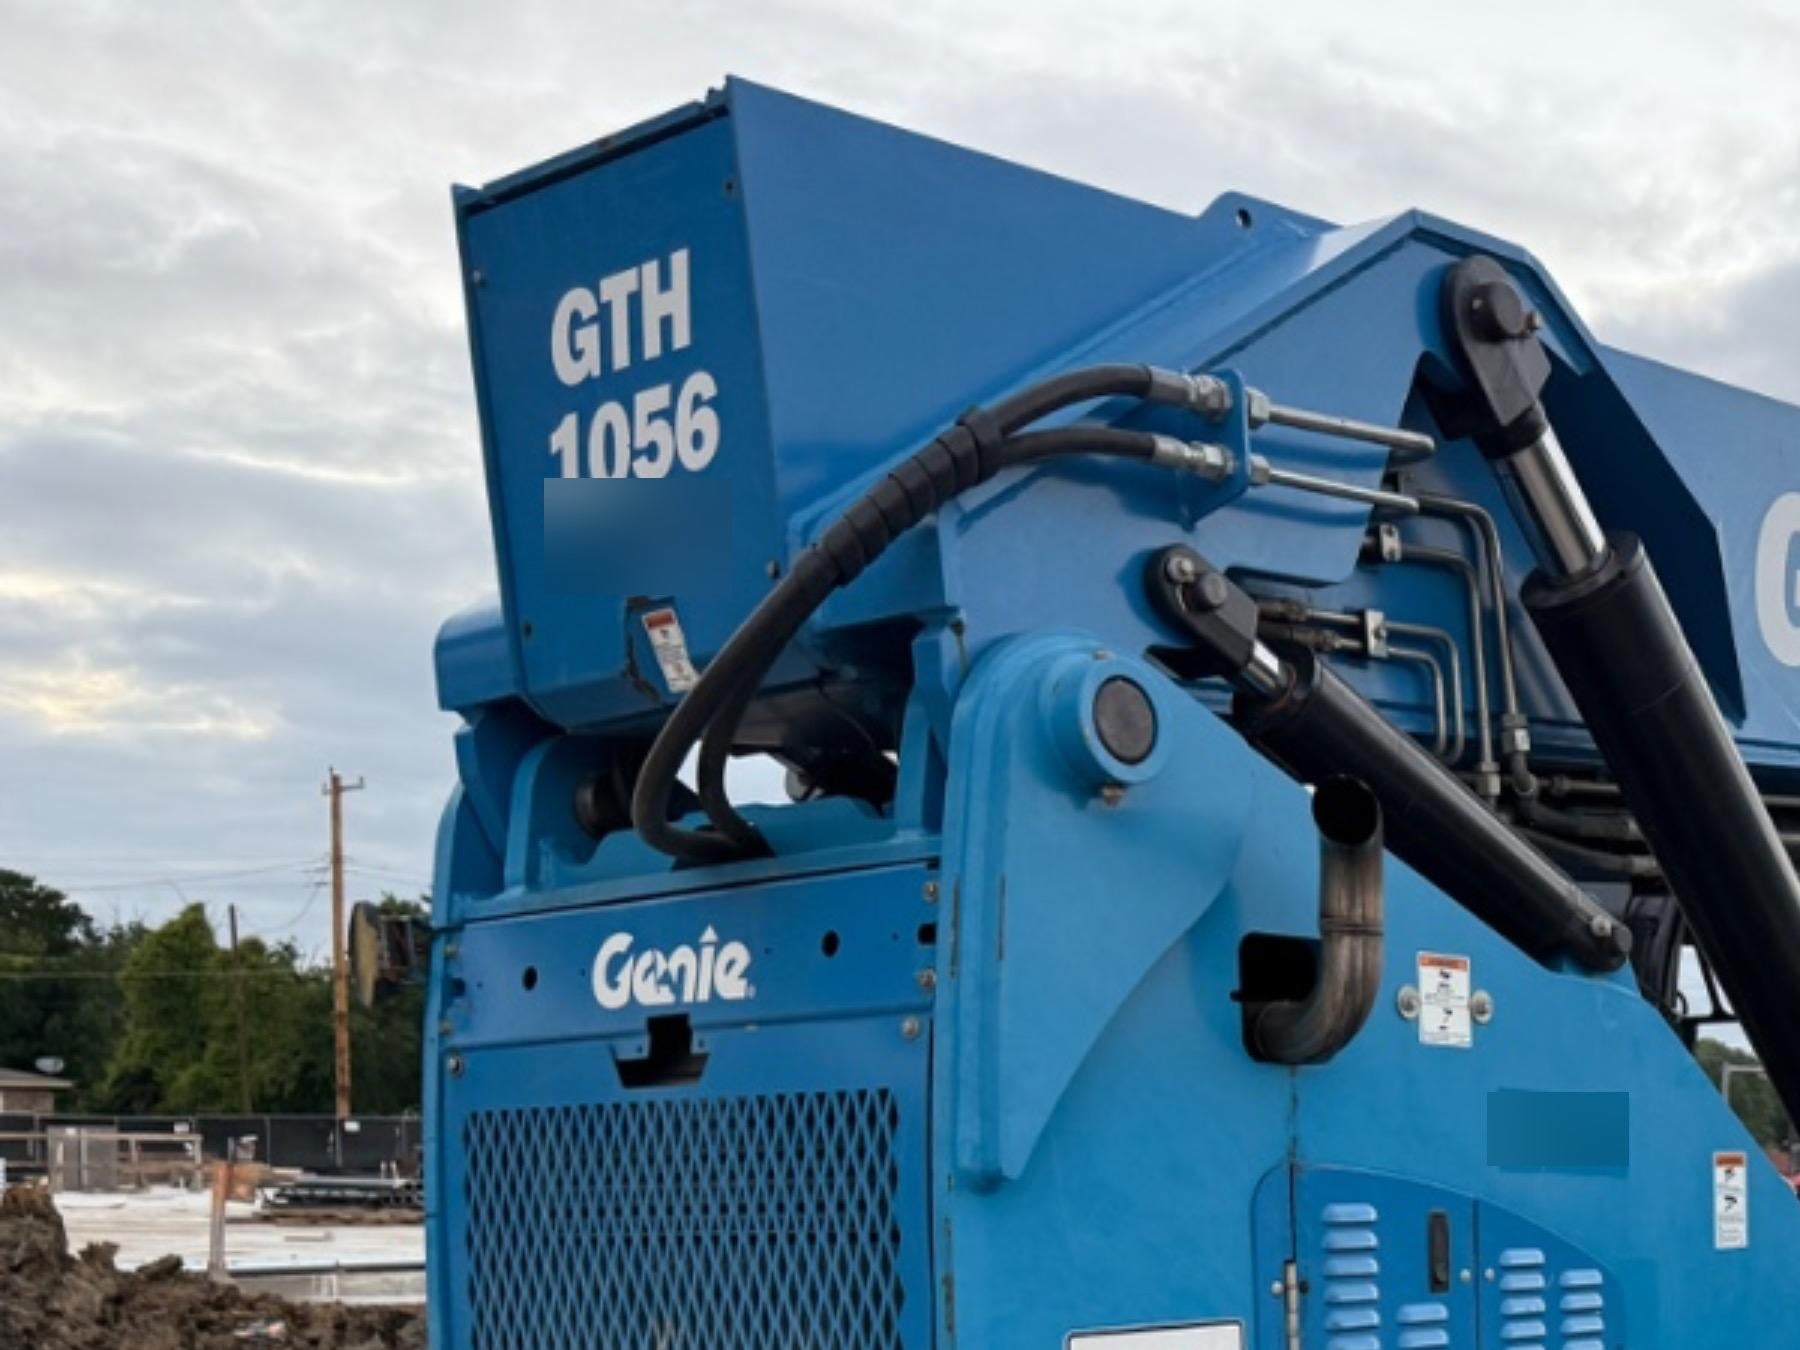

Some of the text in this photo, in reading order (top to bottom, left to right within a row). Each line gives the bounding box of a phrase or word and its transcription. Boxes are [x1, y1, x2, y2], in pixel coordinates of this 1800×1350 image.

[551, 247, 691, 387] GTH
[549, 370, 720, 478] 1056
[592, 924, 751, 1010] Genie
